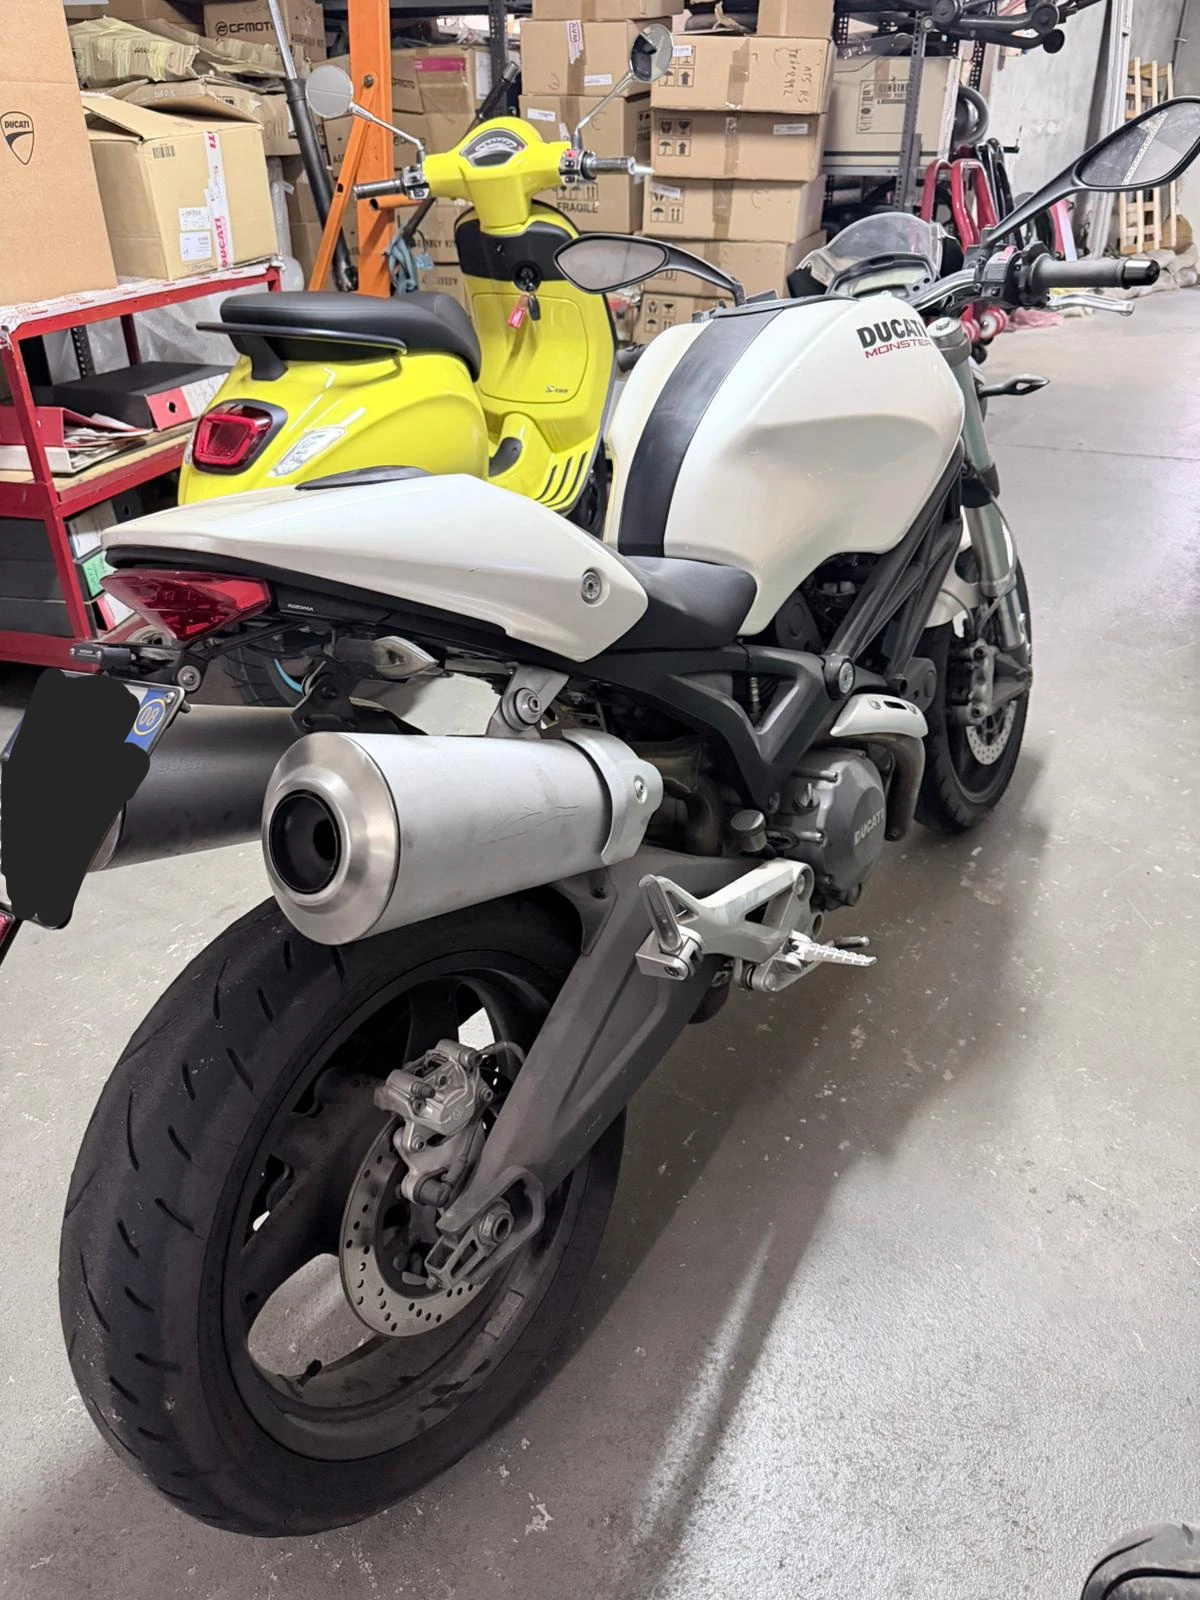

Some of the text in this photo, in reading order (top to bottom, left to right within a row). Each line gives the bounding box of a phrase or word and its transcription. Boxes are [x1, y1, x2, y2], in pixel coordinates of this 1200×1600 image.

[5, 120, 29, 128] DUCATI
[556, 201, 599, 213] FRAGILE
[856, 318, 929, 349] DUCATI
[138, 706, 160, 727] 08
[854, 807, 884, 845] DUCATI
